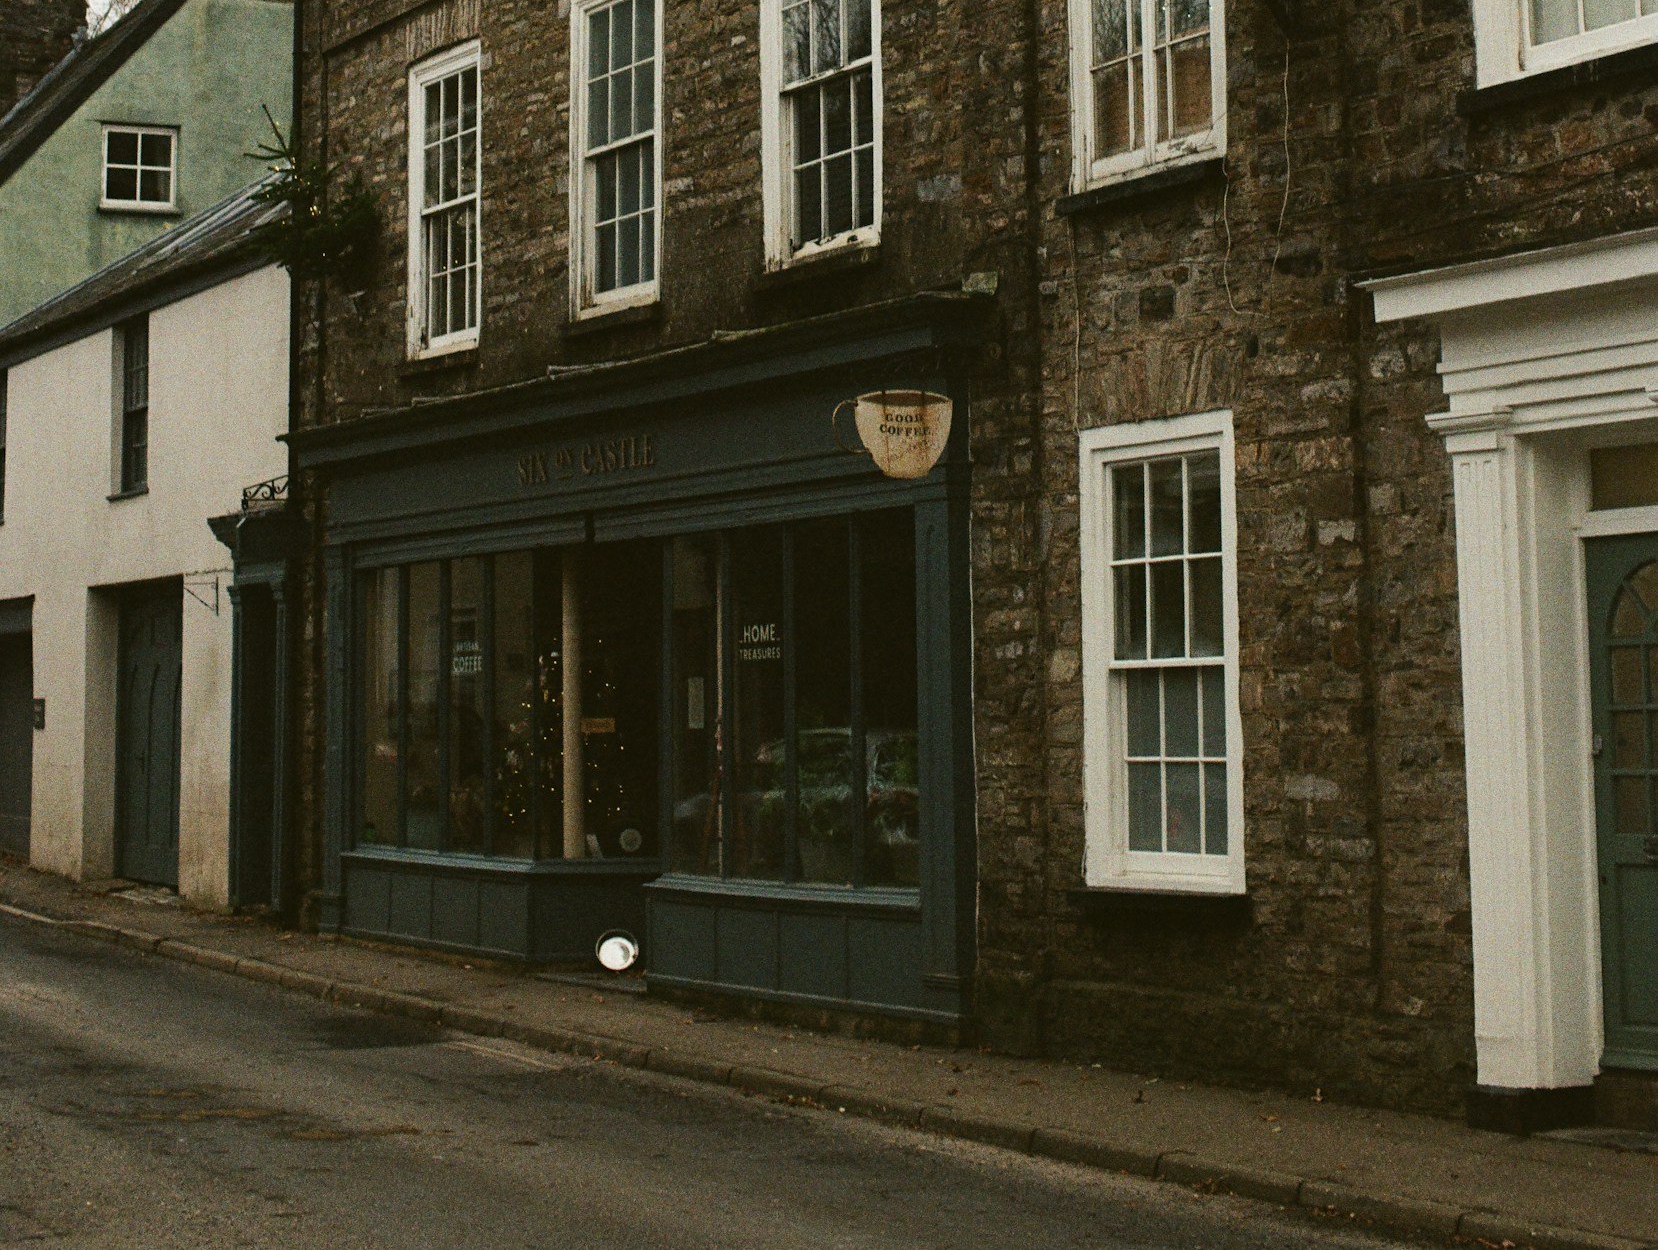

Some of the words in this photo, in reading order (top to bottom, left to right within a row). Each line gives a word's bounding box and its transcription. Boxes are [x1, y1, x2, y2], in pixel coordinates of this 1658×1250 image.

[885, 414, 923, 422] GOOD
[880, 424, 929, 436] COFFEE
[517, 451, 548, 485] SIX
[581, 433, 656, 475] CASTLE
[743, 624, 776, 643] HOME
[739, 647, 781, 660] TREASURES
[453, 656, 482, 673] COFFEE
